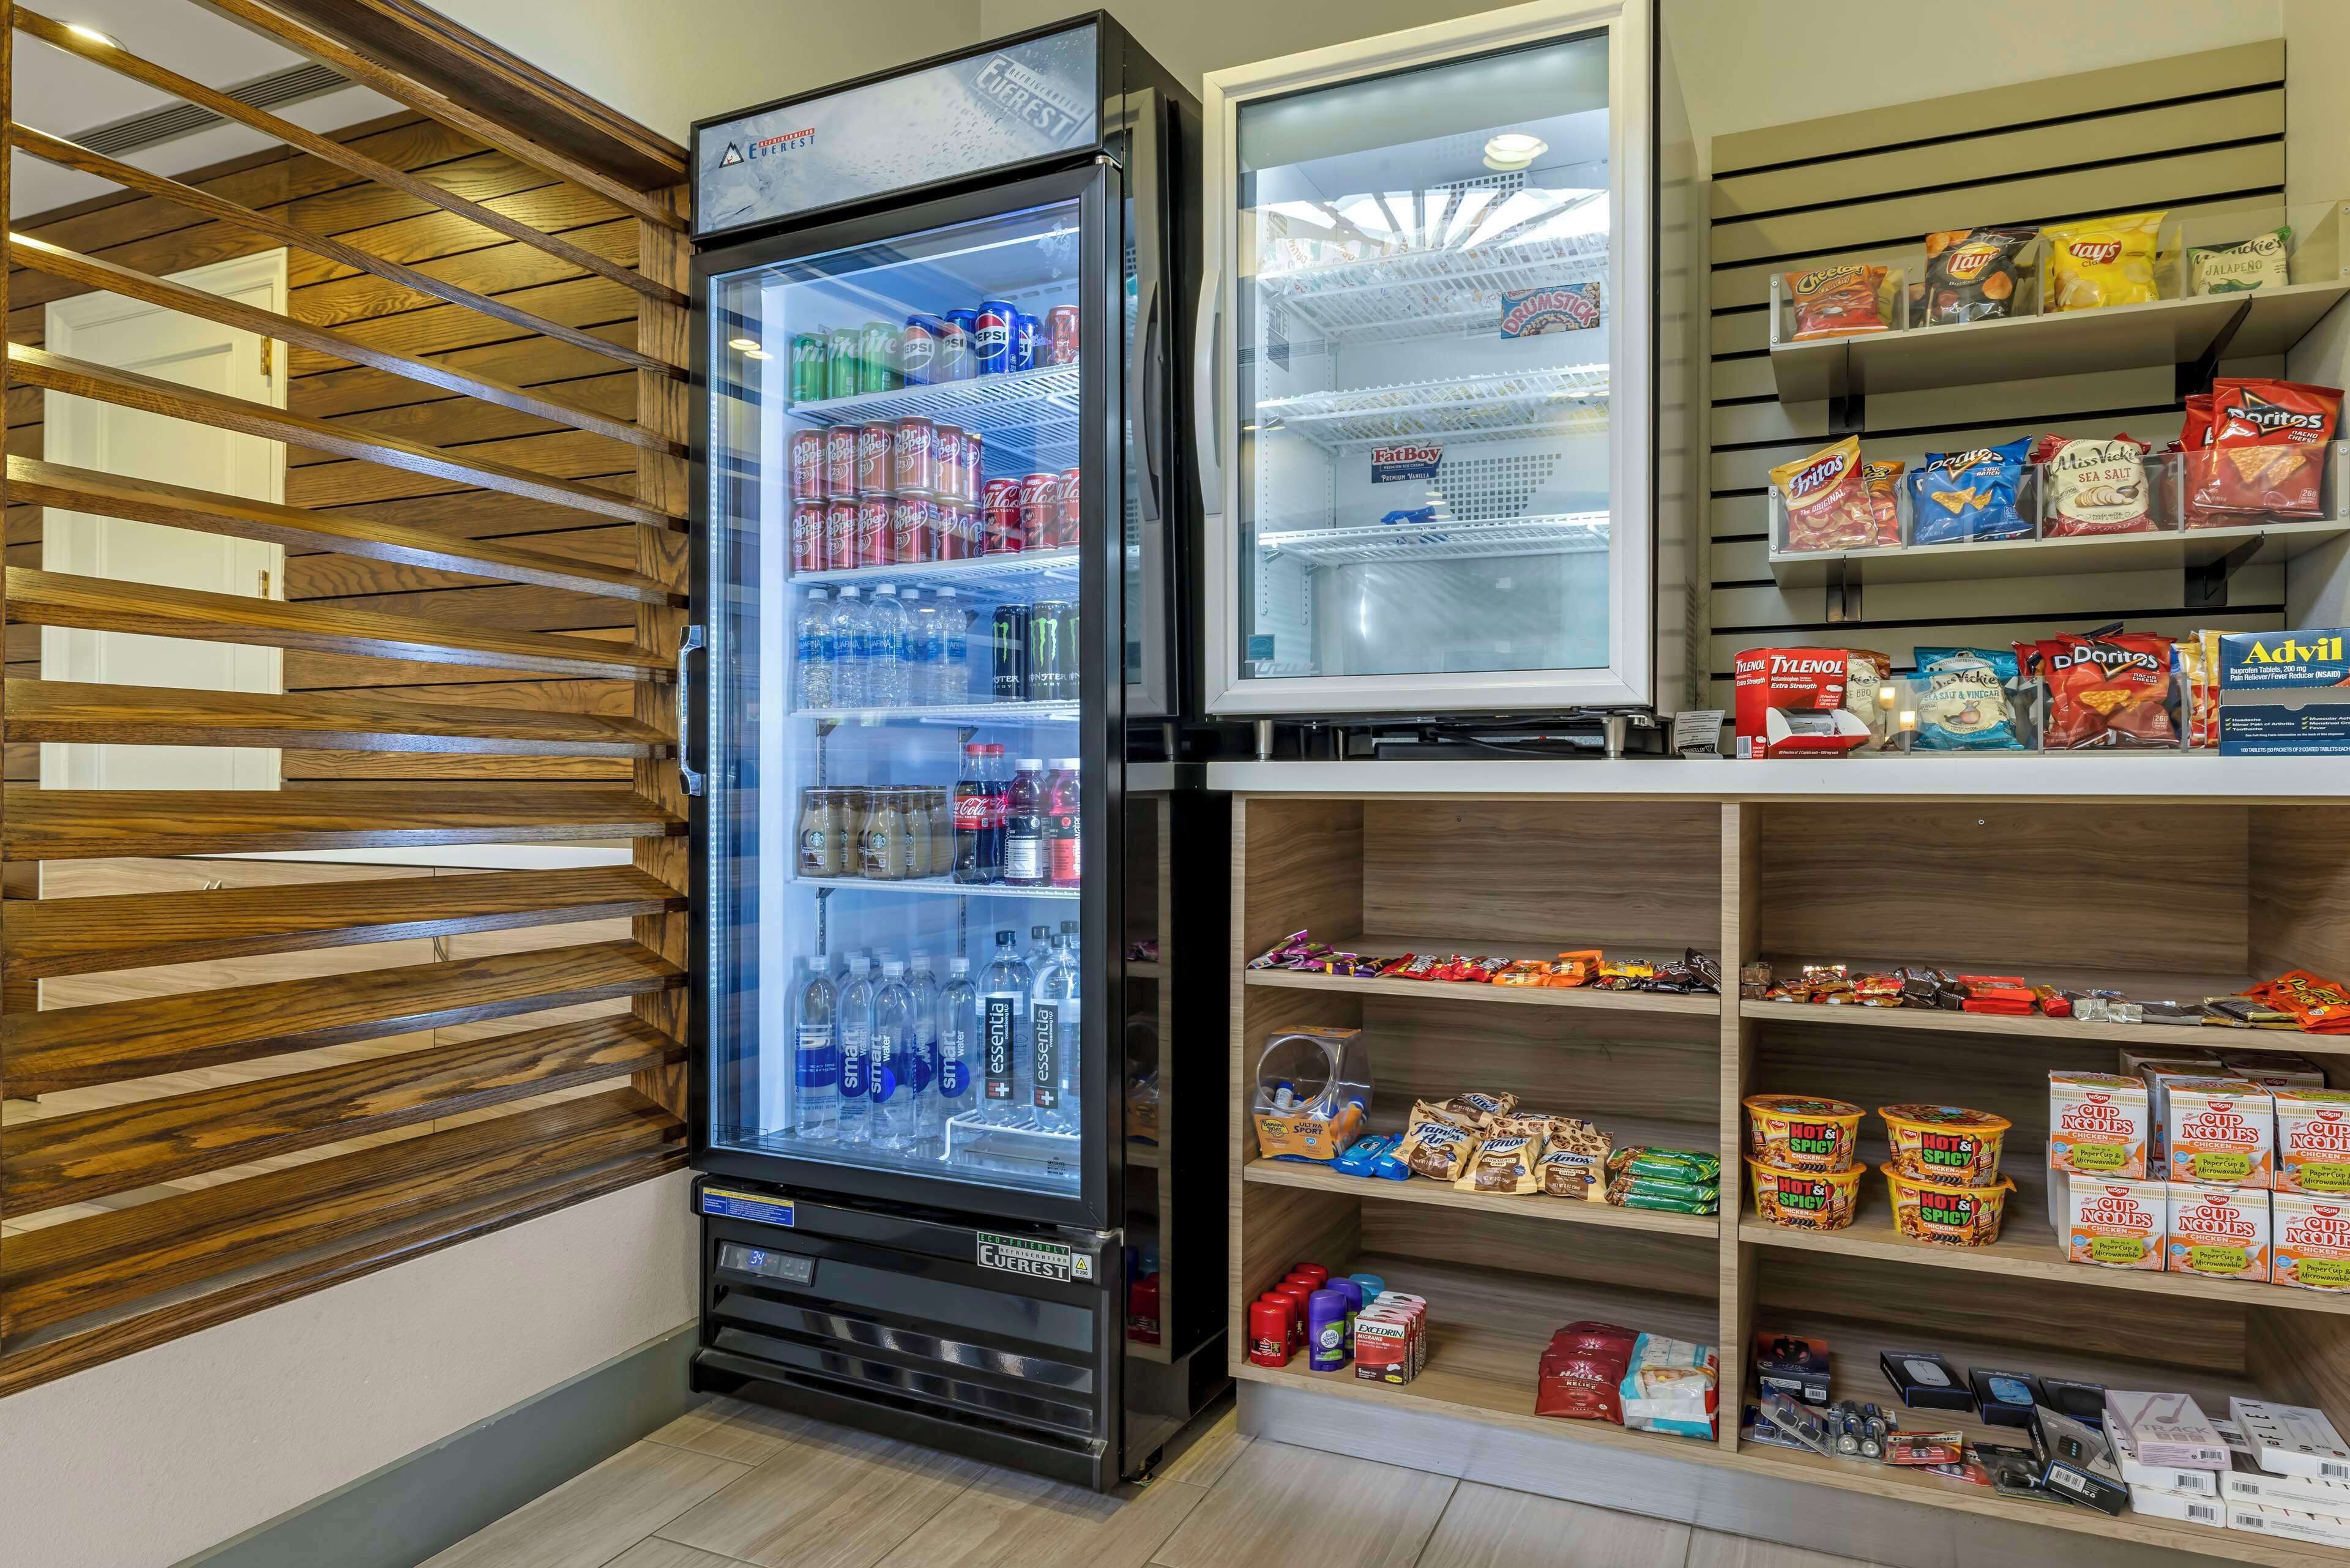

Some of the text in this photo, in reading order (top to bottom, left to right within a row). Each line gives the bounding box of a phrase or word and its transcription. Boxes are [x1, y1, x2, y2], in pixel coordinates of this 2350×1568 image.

[1952, 248, 2001, 273] Lay's
[2071, 242, 2121, 263] Lay's
[2206, 259, 2262, 276] JALAPEÑO
[1796, 264, 1864, 294] Cheetos
[1502, 293, 1597, 333] DRUMSTICK
[975, 330, 1006, 342] EPSI
[905, 343, 932, 354] EPSI
[2228, 408, 2323, 428] Doritos
[835, 437, 851, 451] Dr
[901, 429, 917, 443] Dr
[802, 441, 817, 455] Dr
[1375, 447, 1441, 463] FatBoy
[1928, 449, 2003, 472] Doritos
[1789, 455, 1844, 499] Fritos
[2079, 468, 2131, 482] SEA SALT
[1812, 490, 1846, 512] ORIGINAL
[900, 505, 914, 518] Dr
[2074, 646, 2158, 668] Doritos
[2241, 637, 2343, 664] Advil
[1736, 660, 1765, 674] TYLENOL
[1770, 656, 1843, 674] TYLENOL
[1029, 673, 1067, 681] ONSTER
[1746, 677, 1766, 685] Strength
[1856, 689, 1871, 698] BBQ
[989, 1003, 1004, 1073] essentia
[1037, 1010, 1048, 1081] essentia
[845, 1030, 857, 1088] smart
[871, 1034, 881, 1094] smart
[944, 1030, 955, 1089] smart
[2079, 1105, 2119, 1119] CUP
[2200, 1113, 2243, 1127] CUP
[1294, 1126, 1322, 1135] SPORT
[1791, 1124, 1835, 1139] HOT &
[2062, 1115, 2133, 1134] NOODLES
[2183, 1124, 2258, 1142] NOODLES
[1791, 1138, 1835, 1153] SPICY
[1923, 1135, 1972, 1152] HOT &
[1923, 1149, 1972, 1166] SPICY
[1779, 1178, 1824, 1195] HOT &
[1779, 1192, 1826, 1209] SPICY
[1922, 1193, 1971, 1211] HOT &
[2098, 1198, 2138, 1212] CUP
[1922, 1208, 1971, 1225] SPICY
[2081, 1208, 2152, 1228] NOODLES
[2196, 1206, 2239, 1221] CUP
[2179, 1217, 2255, 1237] NOODLES
[2305, 1217, 2349, 1233] CUP
[980, 1234, 1066, 1255] ECO-FRIENDLY
[751, 1250, 764, 1264] 34
[980, 1245, 1067, 1279] EVEREST
[1000, 1248, 1067, 1263] REFRIGERATION
[1359, 1324, 1403, 1337] EXCEDRIN
[1559, 1371, 1602, 1381] HALLS
[2140, 1424, 2209, 1435] TRACK
